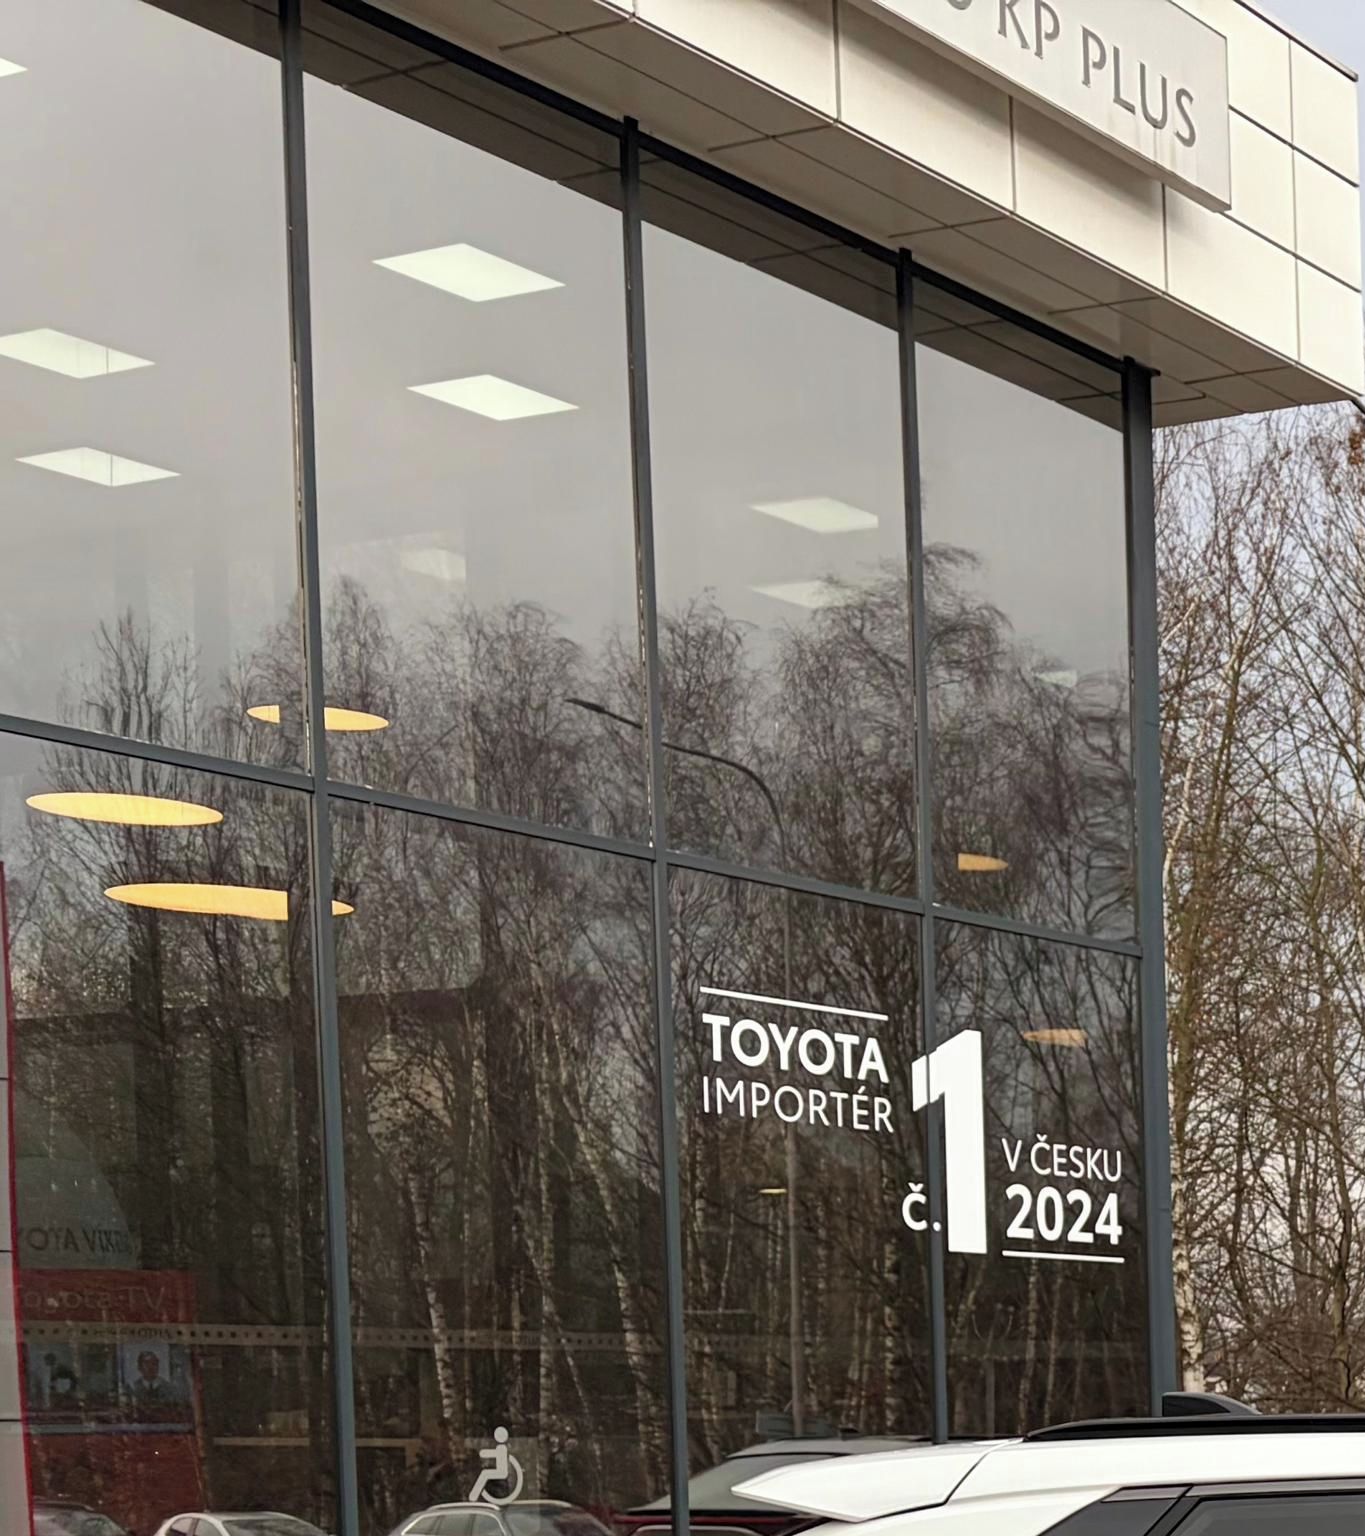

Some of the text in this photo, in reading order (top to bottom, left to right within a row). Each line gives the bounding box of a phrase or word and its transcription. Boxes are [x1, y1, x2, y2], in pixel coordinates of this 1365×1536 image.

[997, 0, 1198, 149] KP PLUS
[702, 1012, 890, 1085] TOYOTA
[702, 1074, 895, 1134] IMPORTÉR
[911, 1029, 988, 1255] 1
[1001, 1133, 1123, 1183] V ČESKU
[1005, 1182, 1123, 1246] 2024
